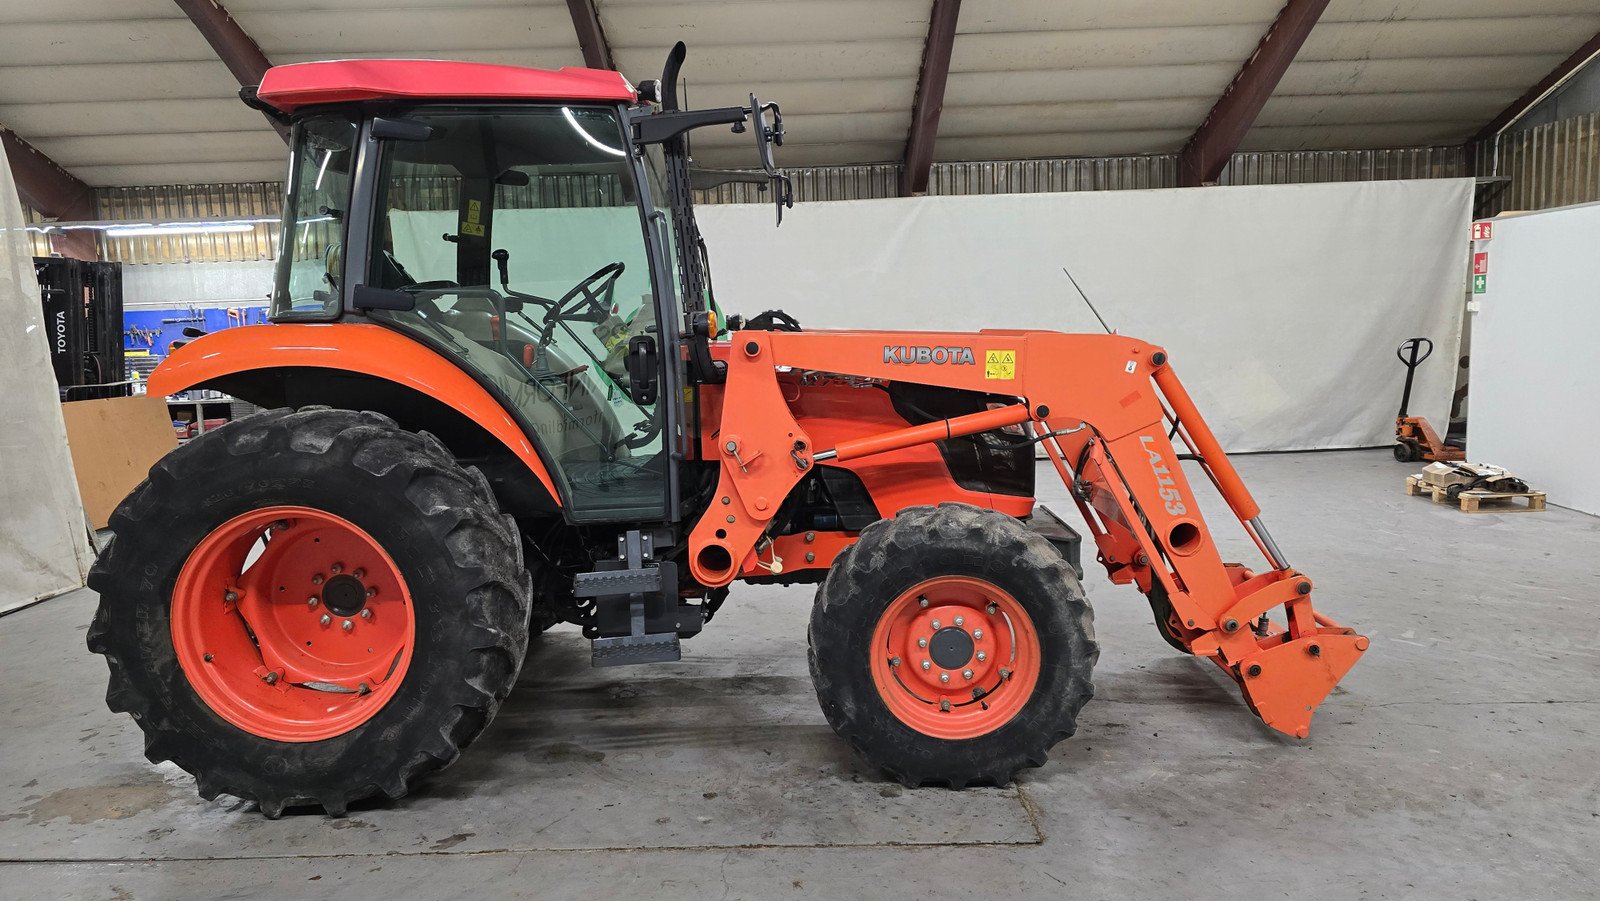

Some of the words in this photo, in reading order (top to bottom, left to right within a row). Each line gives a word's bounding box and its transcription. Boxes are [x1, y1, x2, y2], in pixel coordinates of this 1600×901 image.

[56, 310, 67, 354] TOYOTA
[882, 345, 976, 366] KUBOTA
[1138, 435, 1187, 516] LA1153
